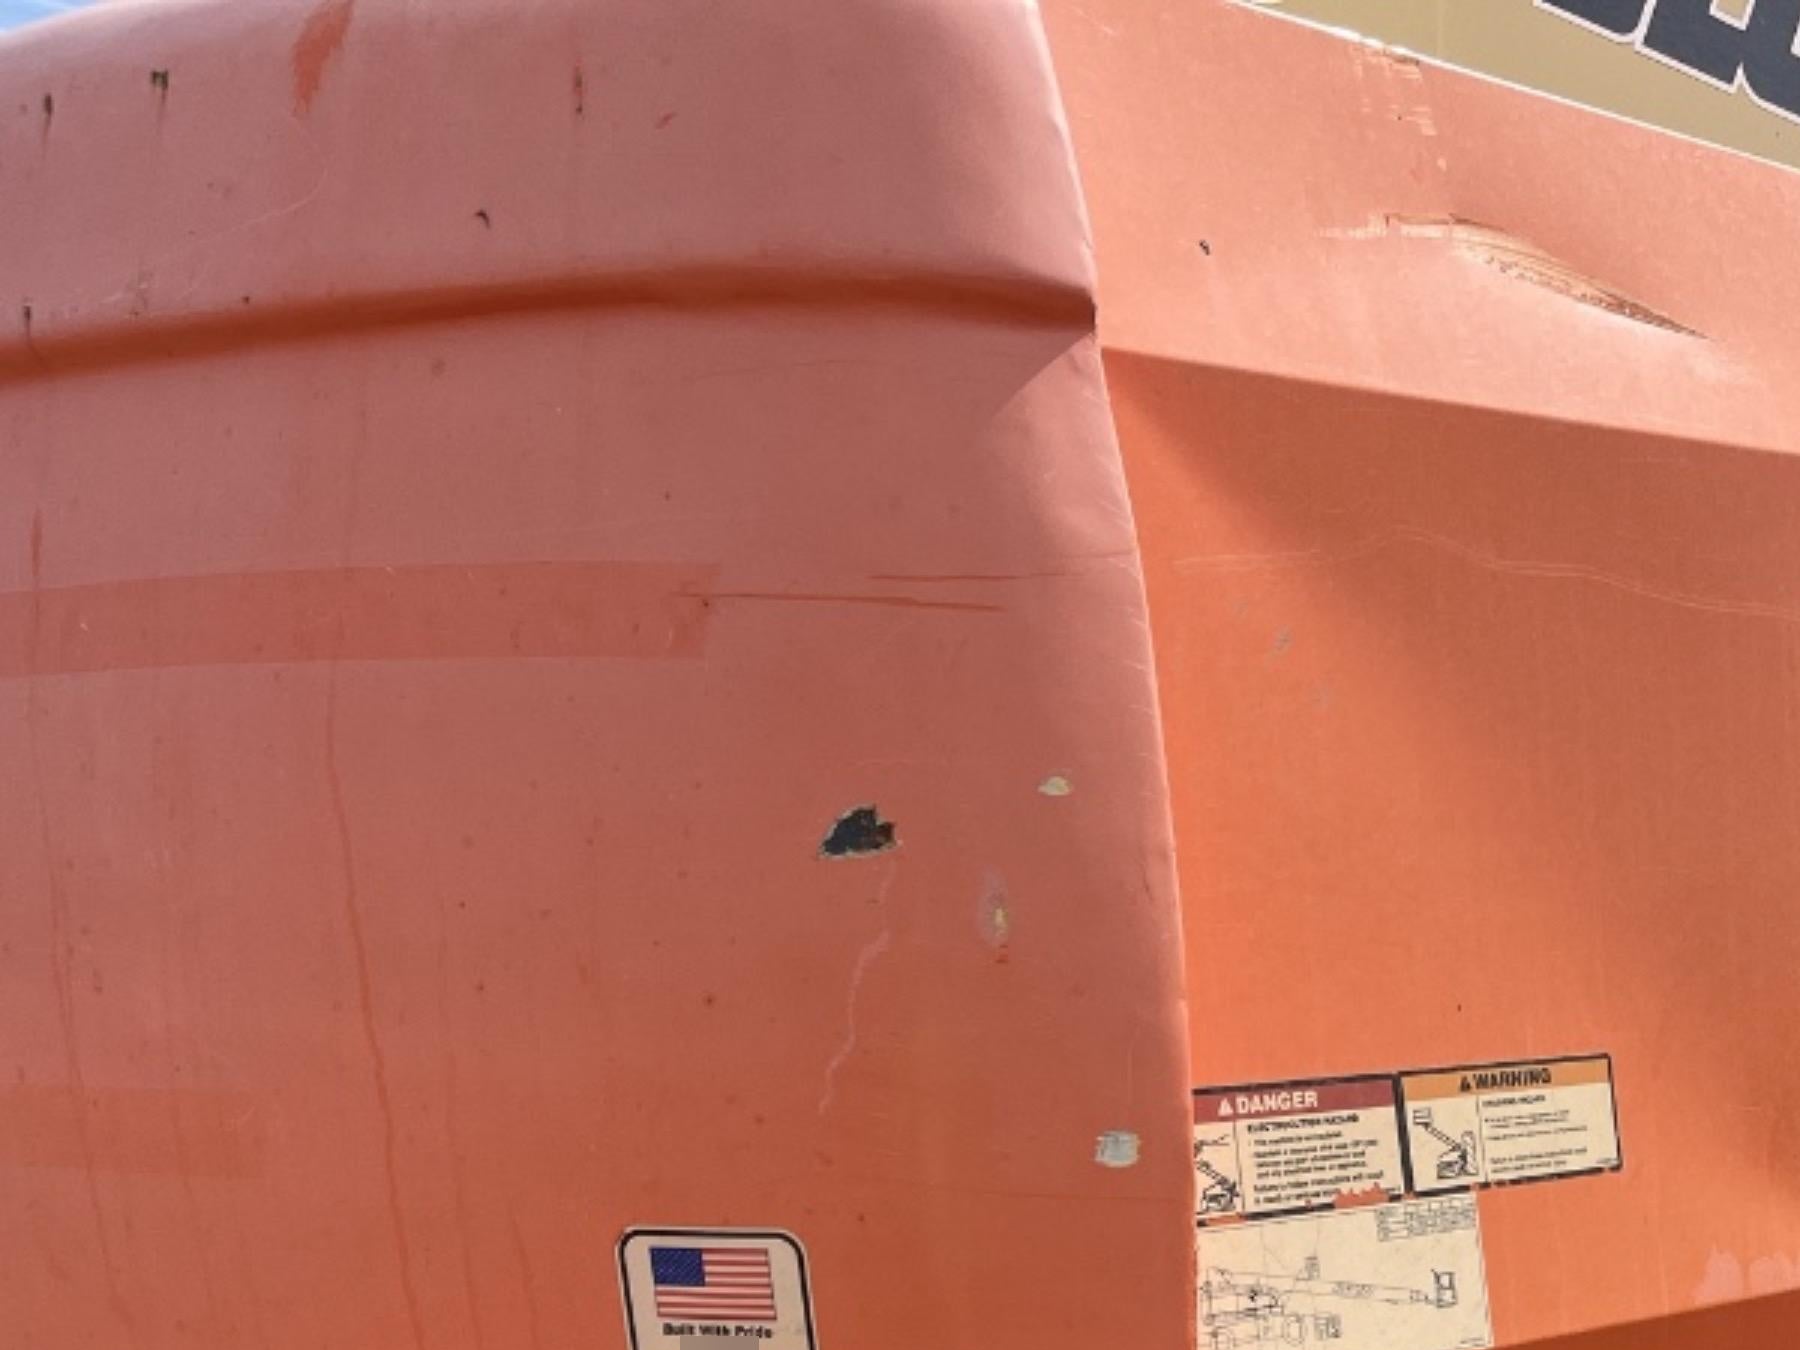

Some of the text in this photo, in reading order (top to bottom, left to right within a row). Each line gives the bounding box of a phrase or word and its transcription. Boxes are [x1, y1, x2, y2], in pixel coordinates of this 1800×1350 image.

[1472, 1067, 1552, 1090] WARNING
[1235, 1090, 1319, 1115] DANGER
[662, 1322, 773, 1340] Built With Pride
